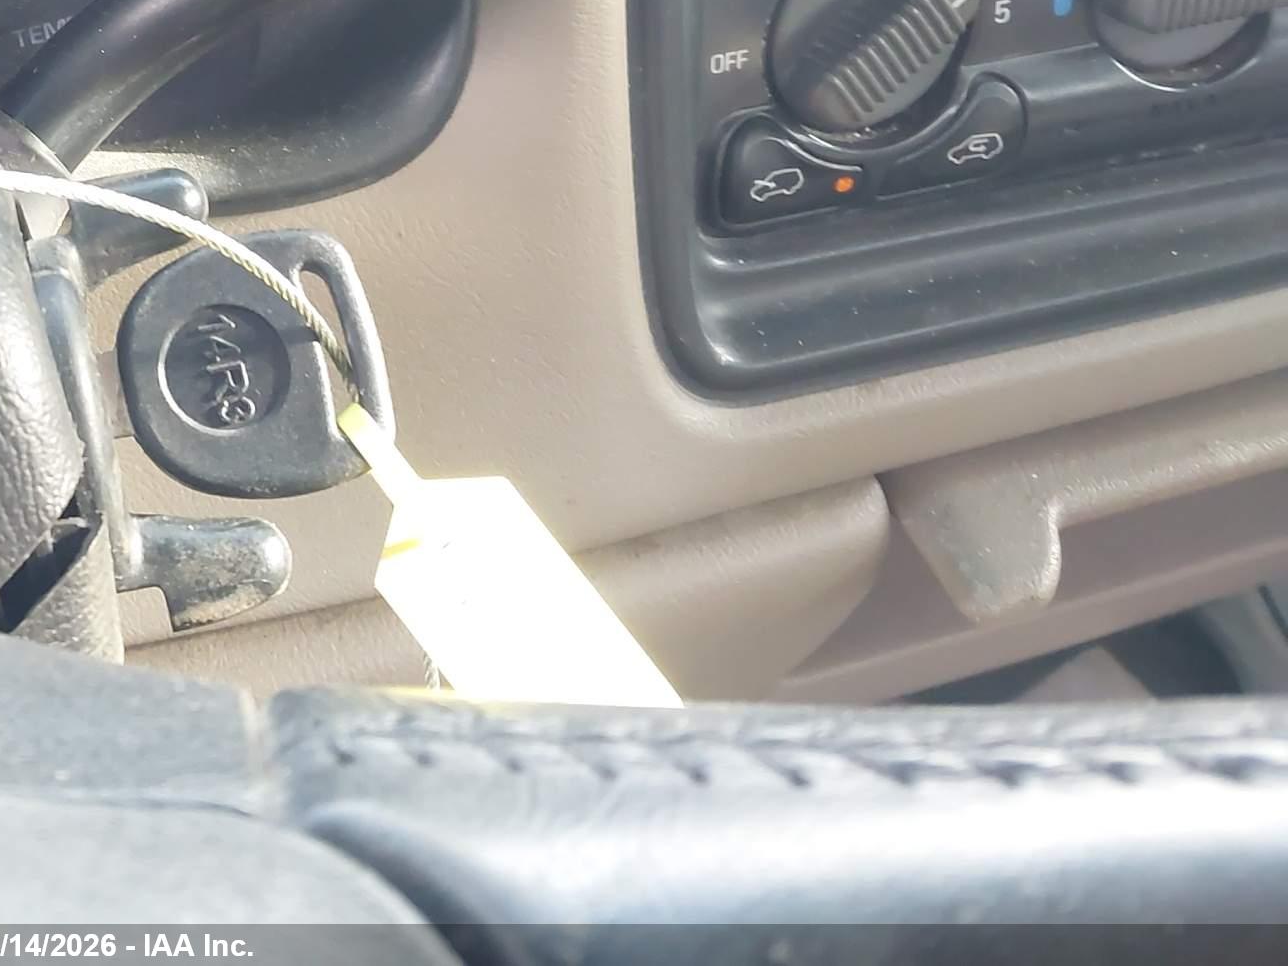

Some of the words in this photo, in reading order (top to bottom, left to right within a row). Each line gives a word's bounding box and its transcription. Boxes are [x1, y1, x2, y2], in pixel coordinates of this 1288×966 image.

[994, 0, 1011, 23] 5
[11, 16, 72, 47] TEM
[710, 50, 749, 74] OFF
